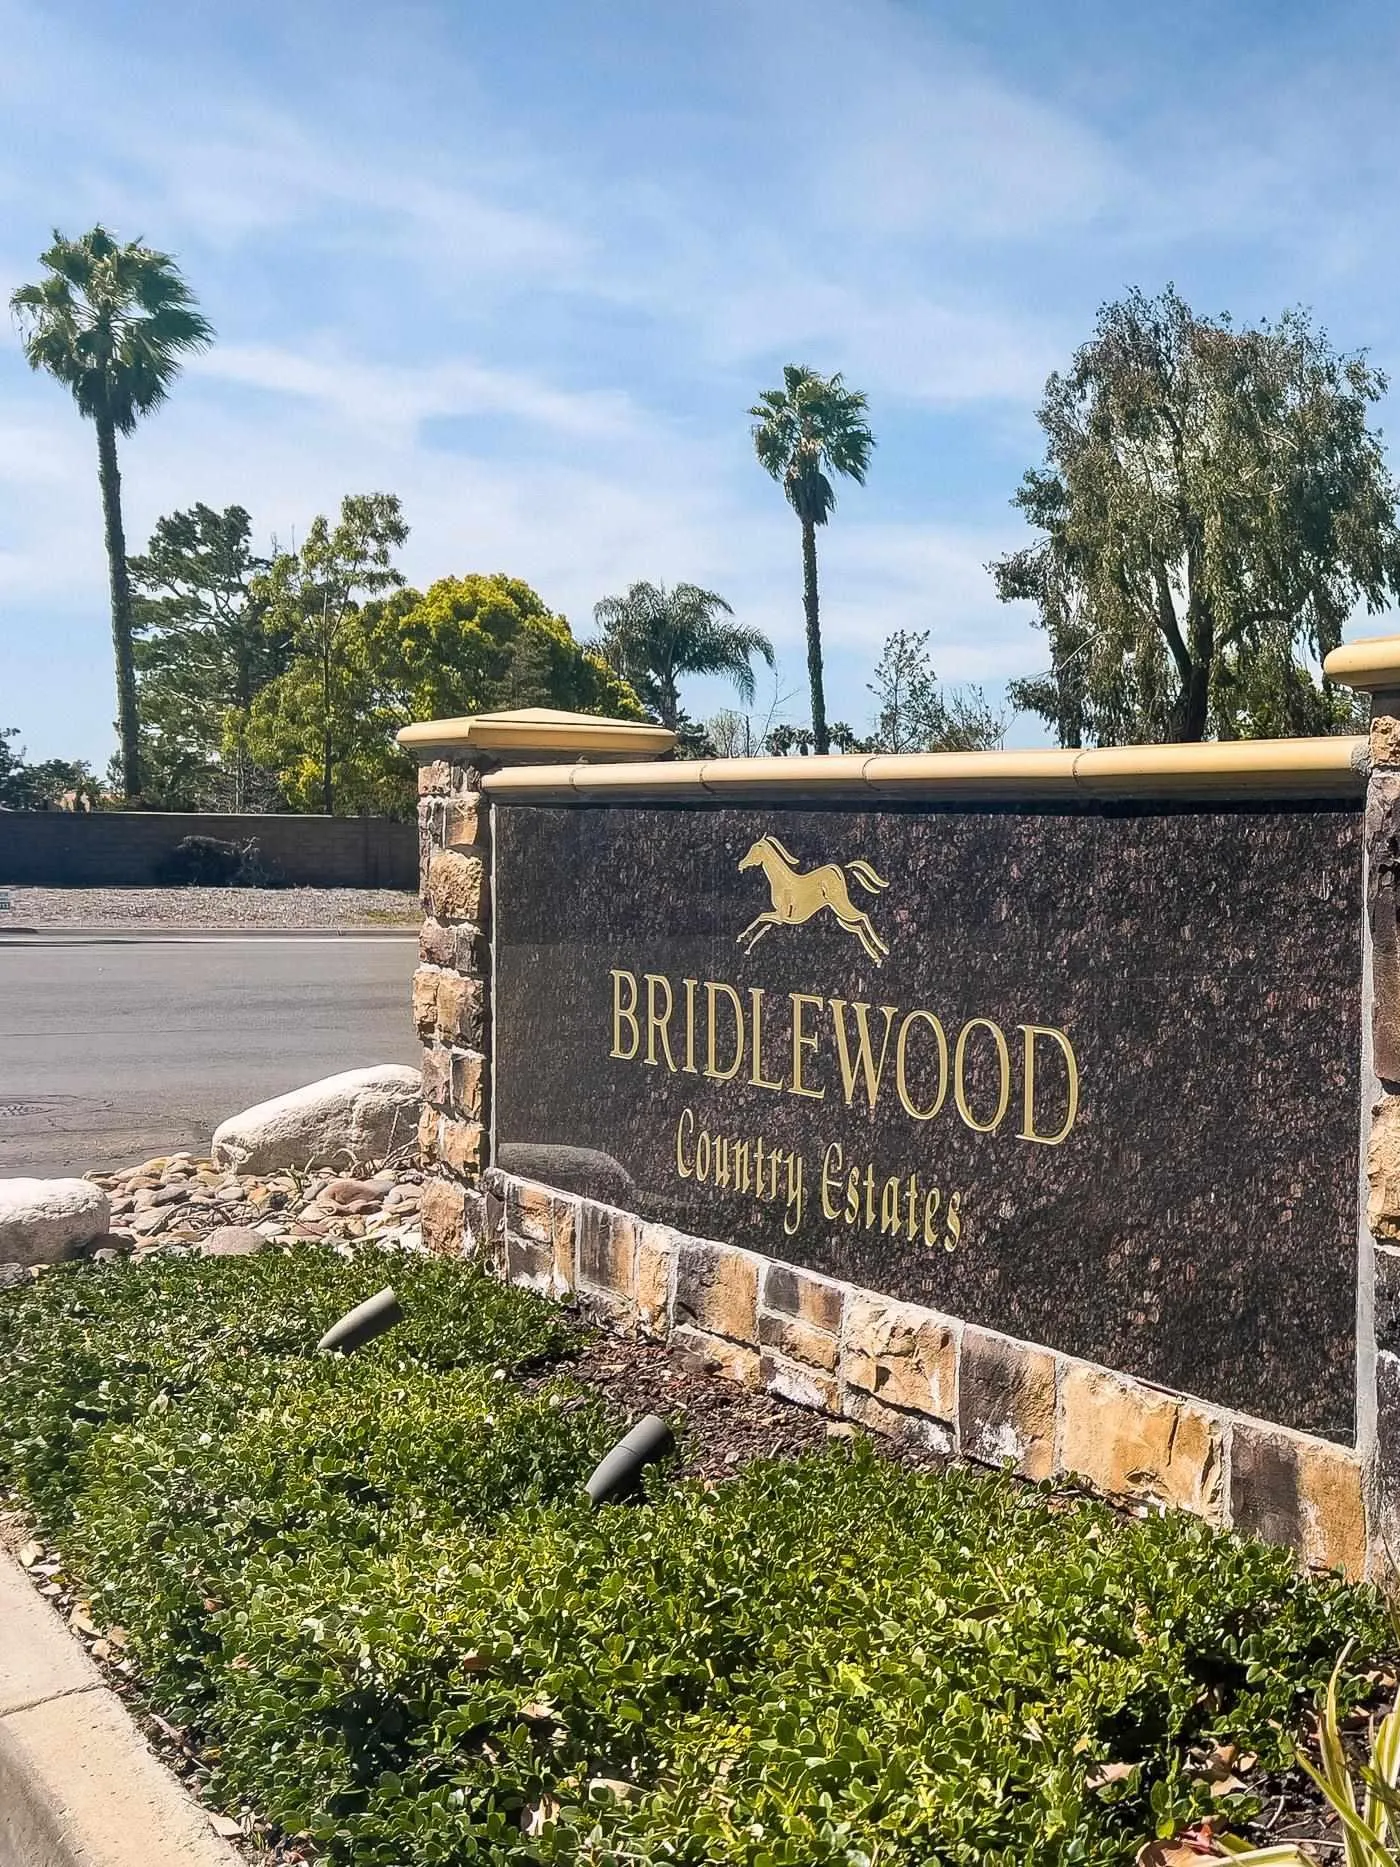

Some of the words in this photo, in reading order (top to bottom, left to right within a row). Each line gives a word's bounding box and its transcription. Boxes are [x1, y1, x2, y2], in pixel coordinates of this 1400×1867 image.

[608, 968, 1080, 1145] BRIDLEWOOD
[675, 1107, 803, 1236] Country
[821, 1141, 962, 1253] Estates
